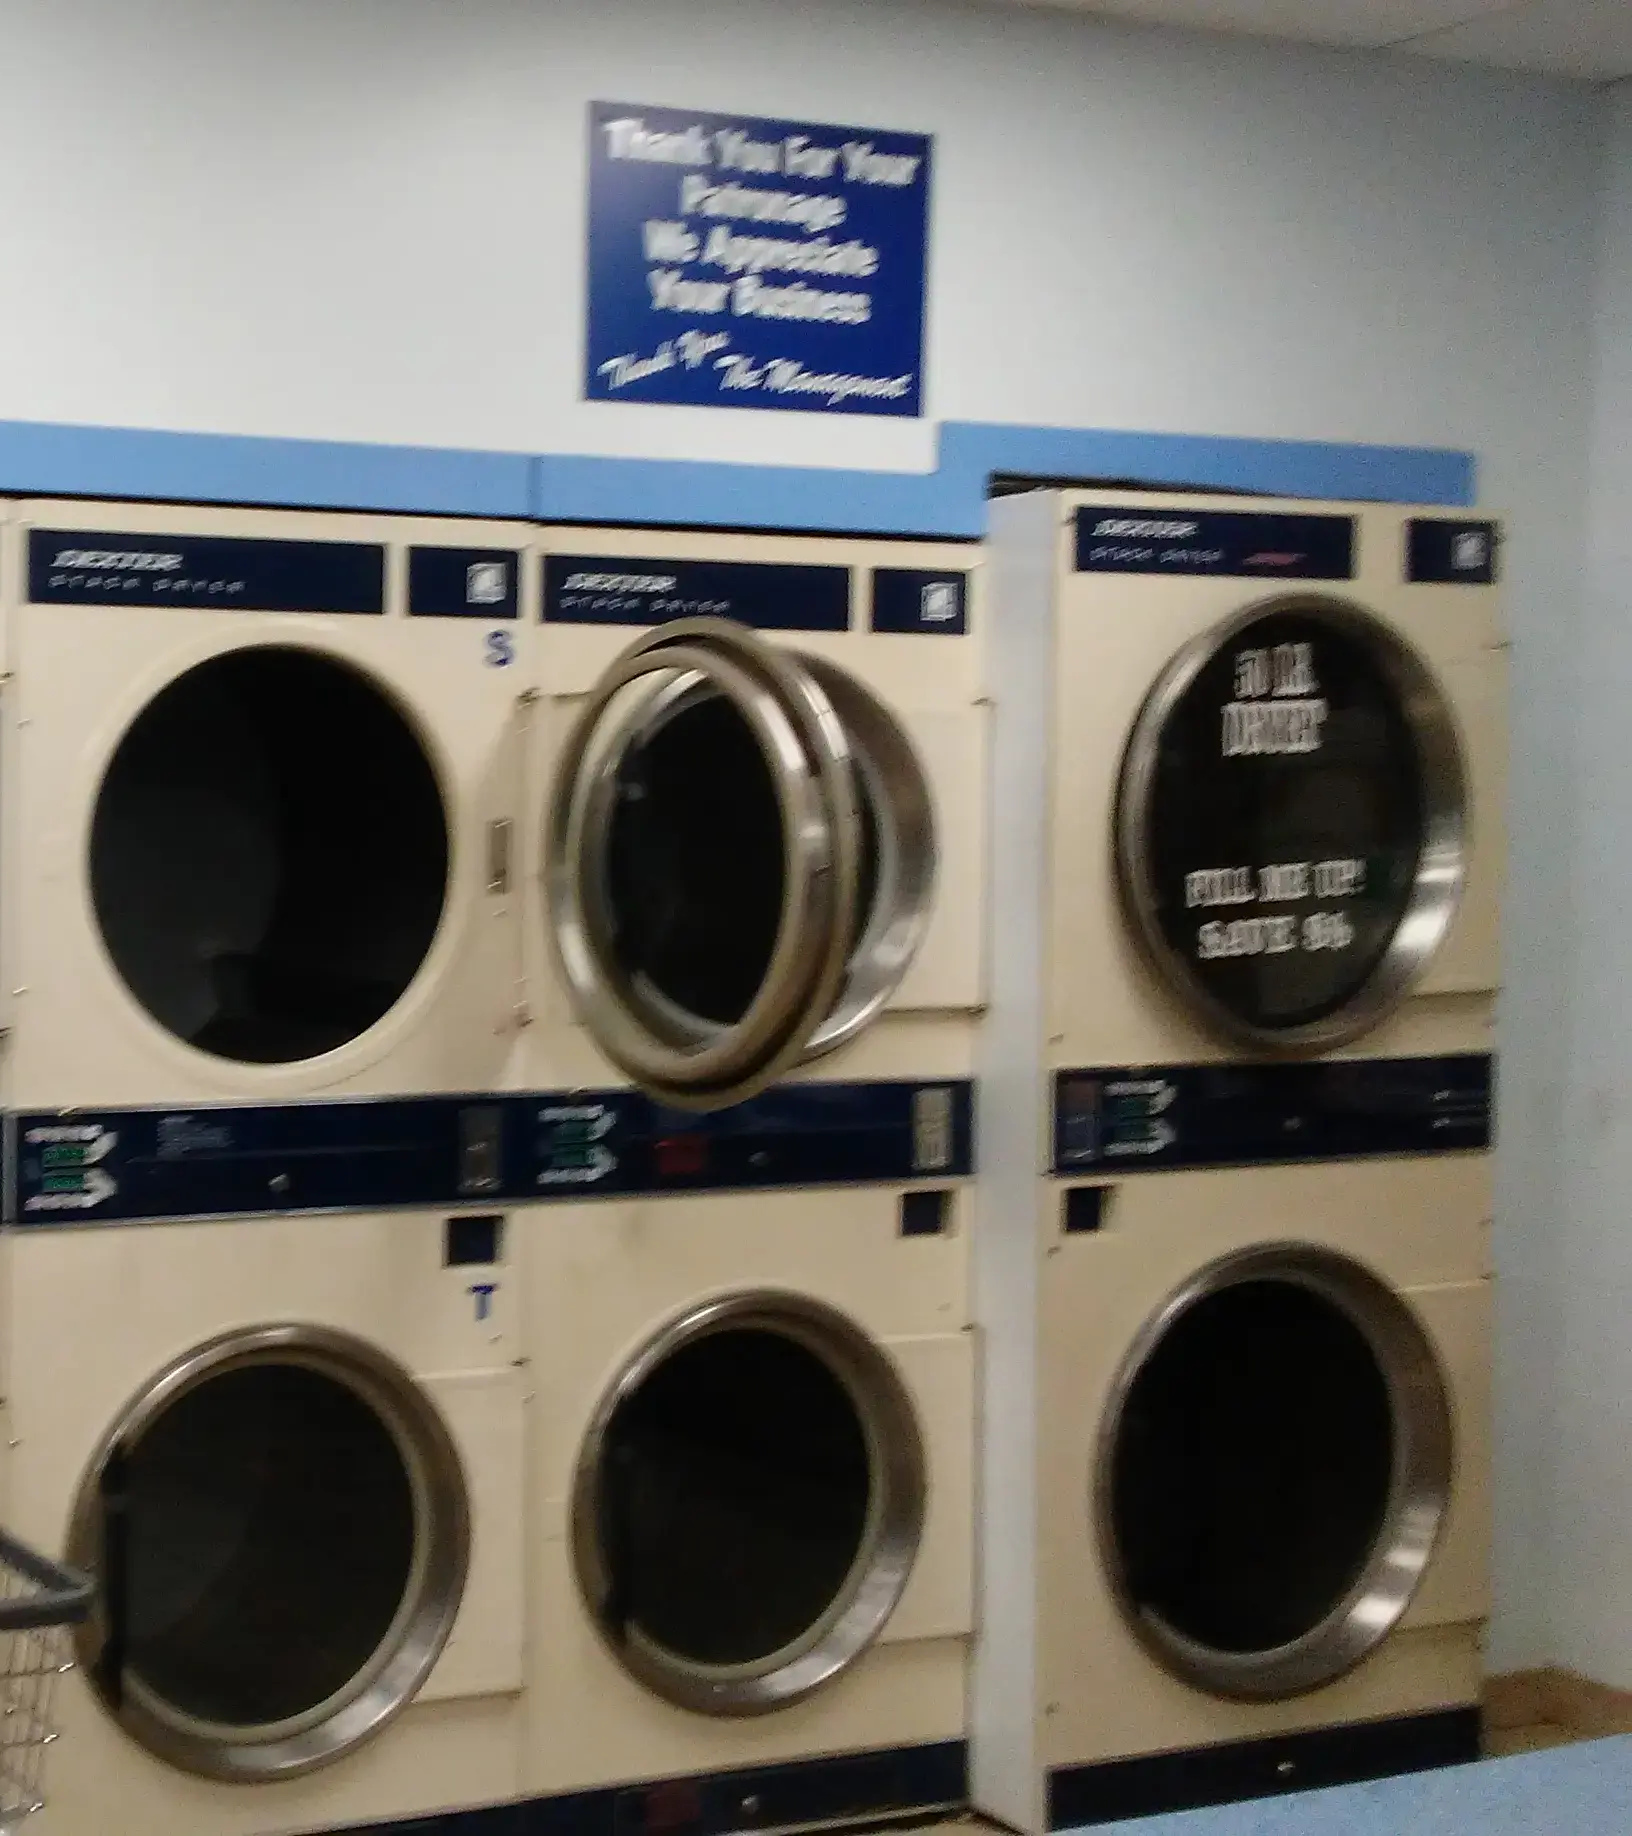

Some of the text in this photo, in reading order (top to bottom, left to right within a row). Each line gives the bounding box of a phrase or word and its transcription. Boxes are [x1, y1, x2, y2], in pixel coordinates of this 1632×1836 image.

[602, 117, 920, 187] Thank You For Your
[681, 174, 848, 233] Patronage
[642, 219, 880, 277] We Appreciate
[646, 269, 873, 325] Your Business
[597, 340, 676, 390] Thank
[484, 629, 516, 669] S
[468, 1284, 499, 1321] T
